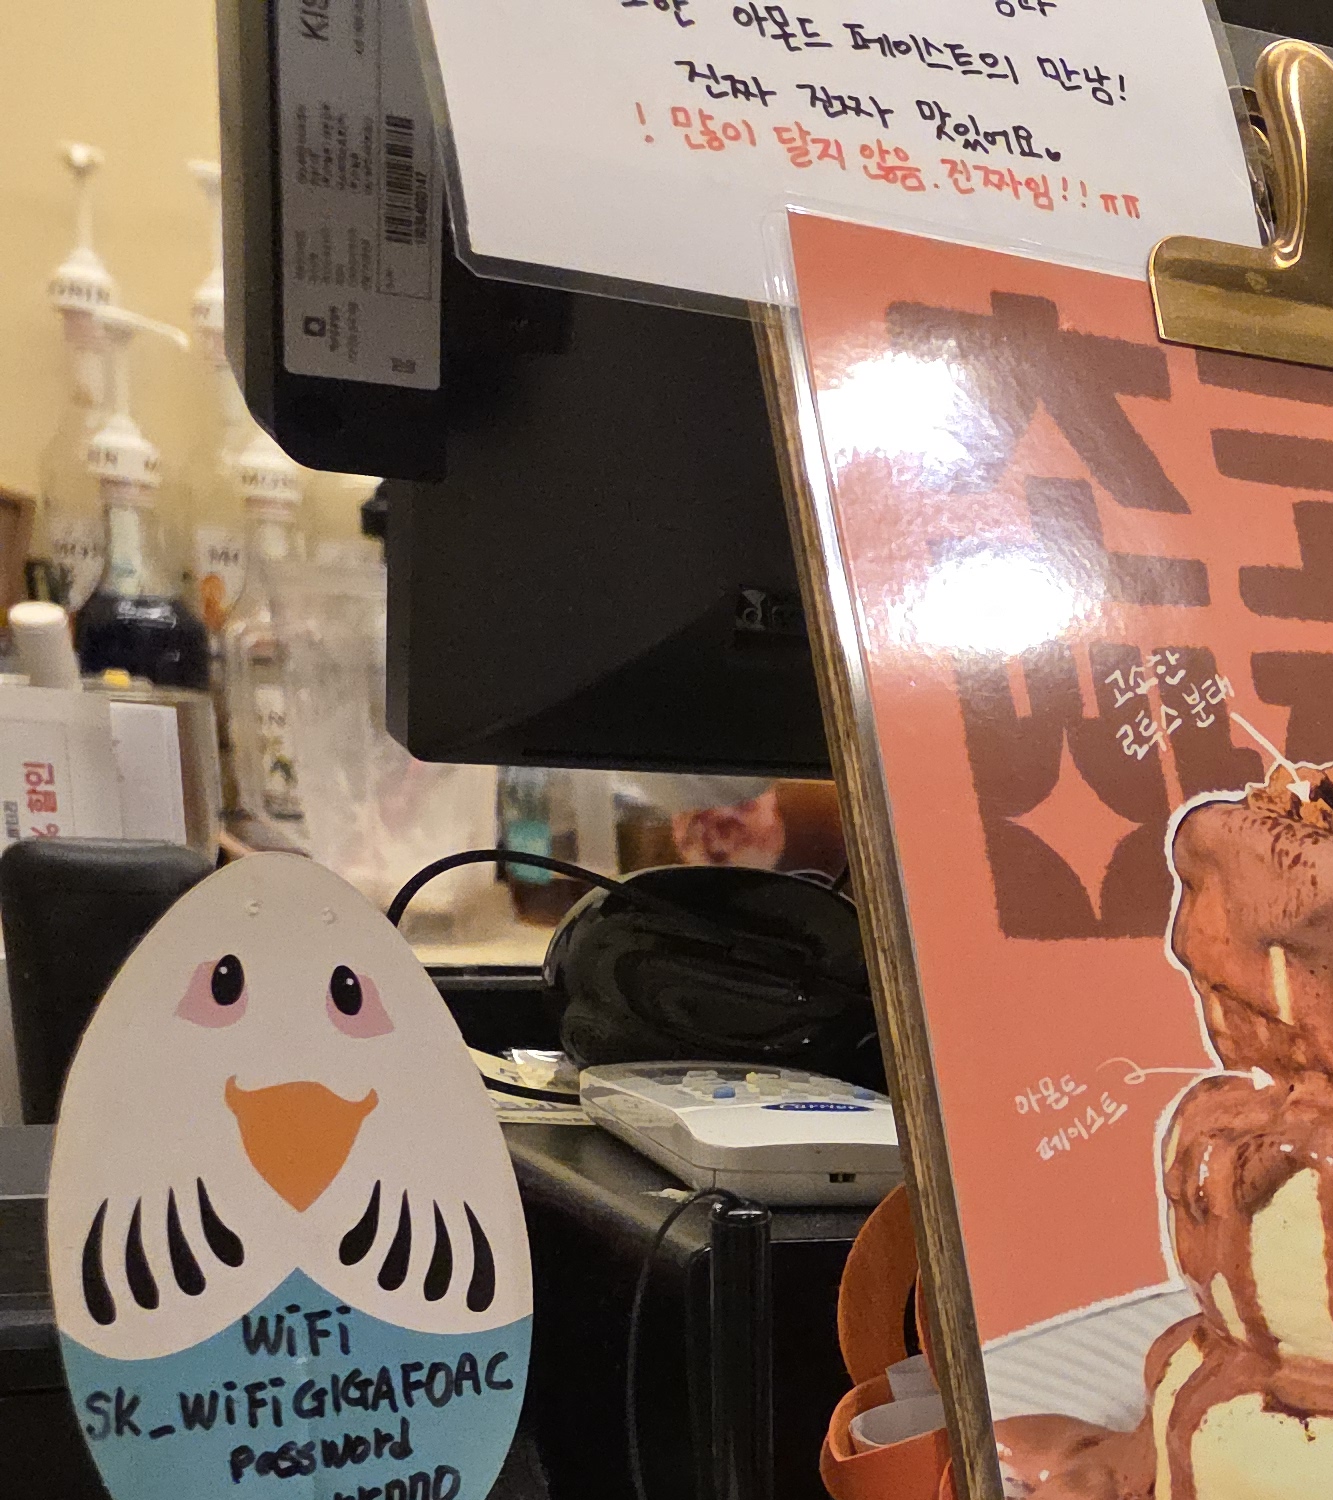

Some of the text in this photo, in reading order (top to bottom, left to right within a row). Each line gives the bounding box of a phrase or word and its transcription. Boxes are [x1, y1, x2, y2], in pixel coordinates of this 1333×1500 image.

[733, 4, 832, 53] 아몬드
[843, 22, 1018, 84] 페이스트의
[675, 60, 776, 107] 진짜
[796, 83, 895, 128] 진짜
[670, 107, 756, 151] 많이
[773, 121, 847, 170] 달지
[1105, 650, 1186, 708] 고소한
[1116, 703, 1182, 760] 로투스
[23, 761, 58, 814] 할인
[1015, 1074, 1087, 1114] 아몬드
[1036, 1092, 1128, 1160] 페이스트
[242, 1306, 352, 1357] WiFi
